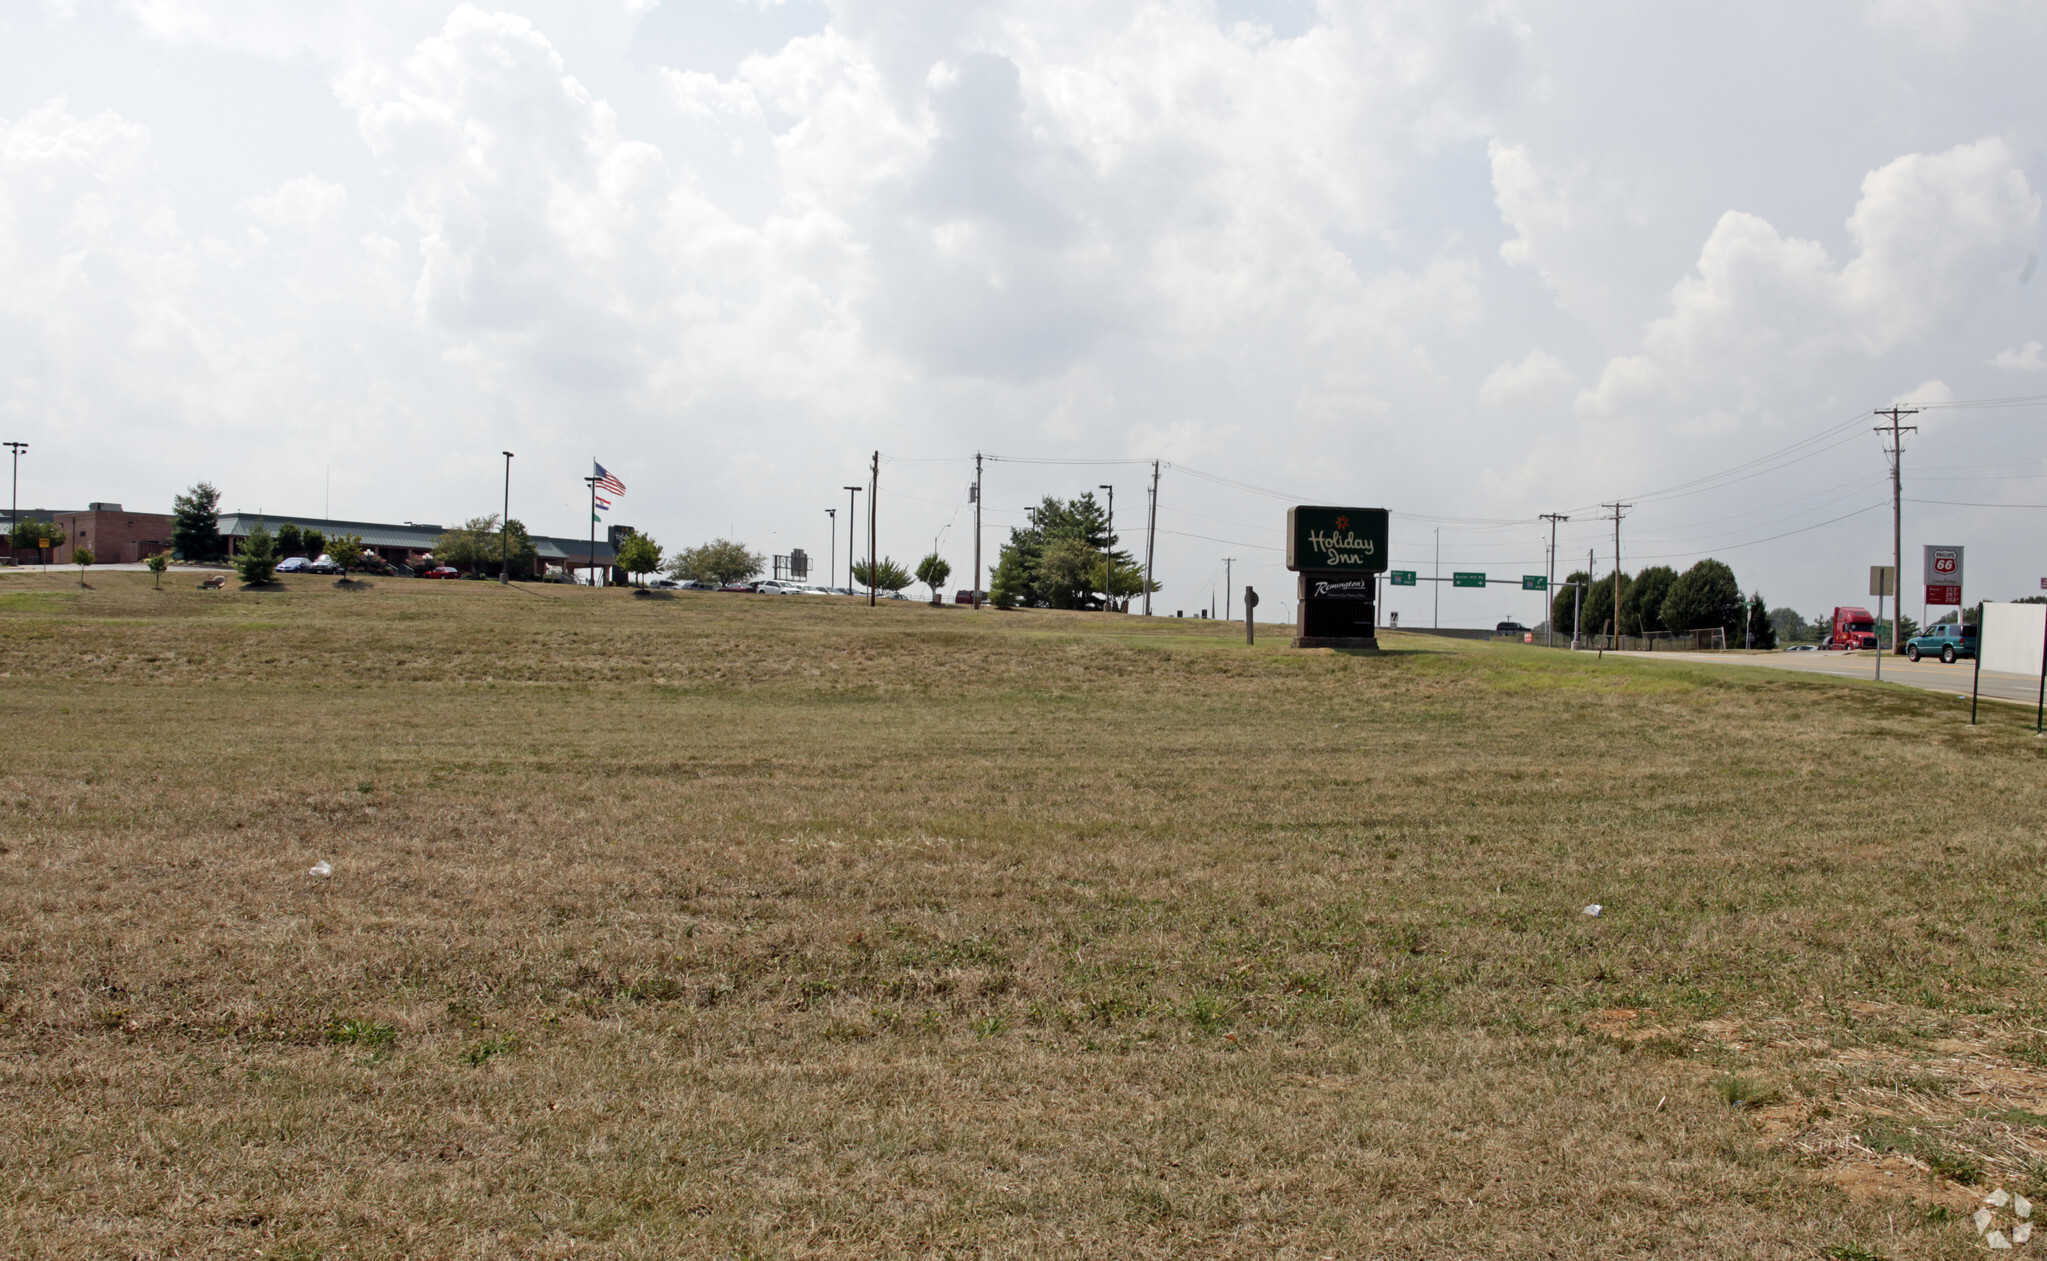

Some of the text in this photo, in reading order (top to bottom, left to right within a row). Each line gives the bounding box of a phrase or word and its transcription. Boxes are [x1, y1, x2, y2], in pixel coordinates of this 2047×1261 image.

[1308, 529, 1375, 555] Holiday
[1327, 548, 1364, 565] Inn
[1936, 559, 1954, 570] 66
[1314, 579, 1366, 597] Remington's
